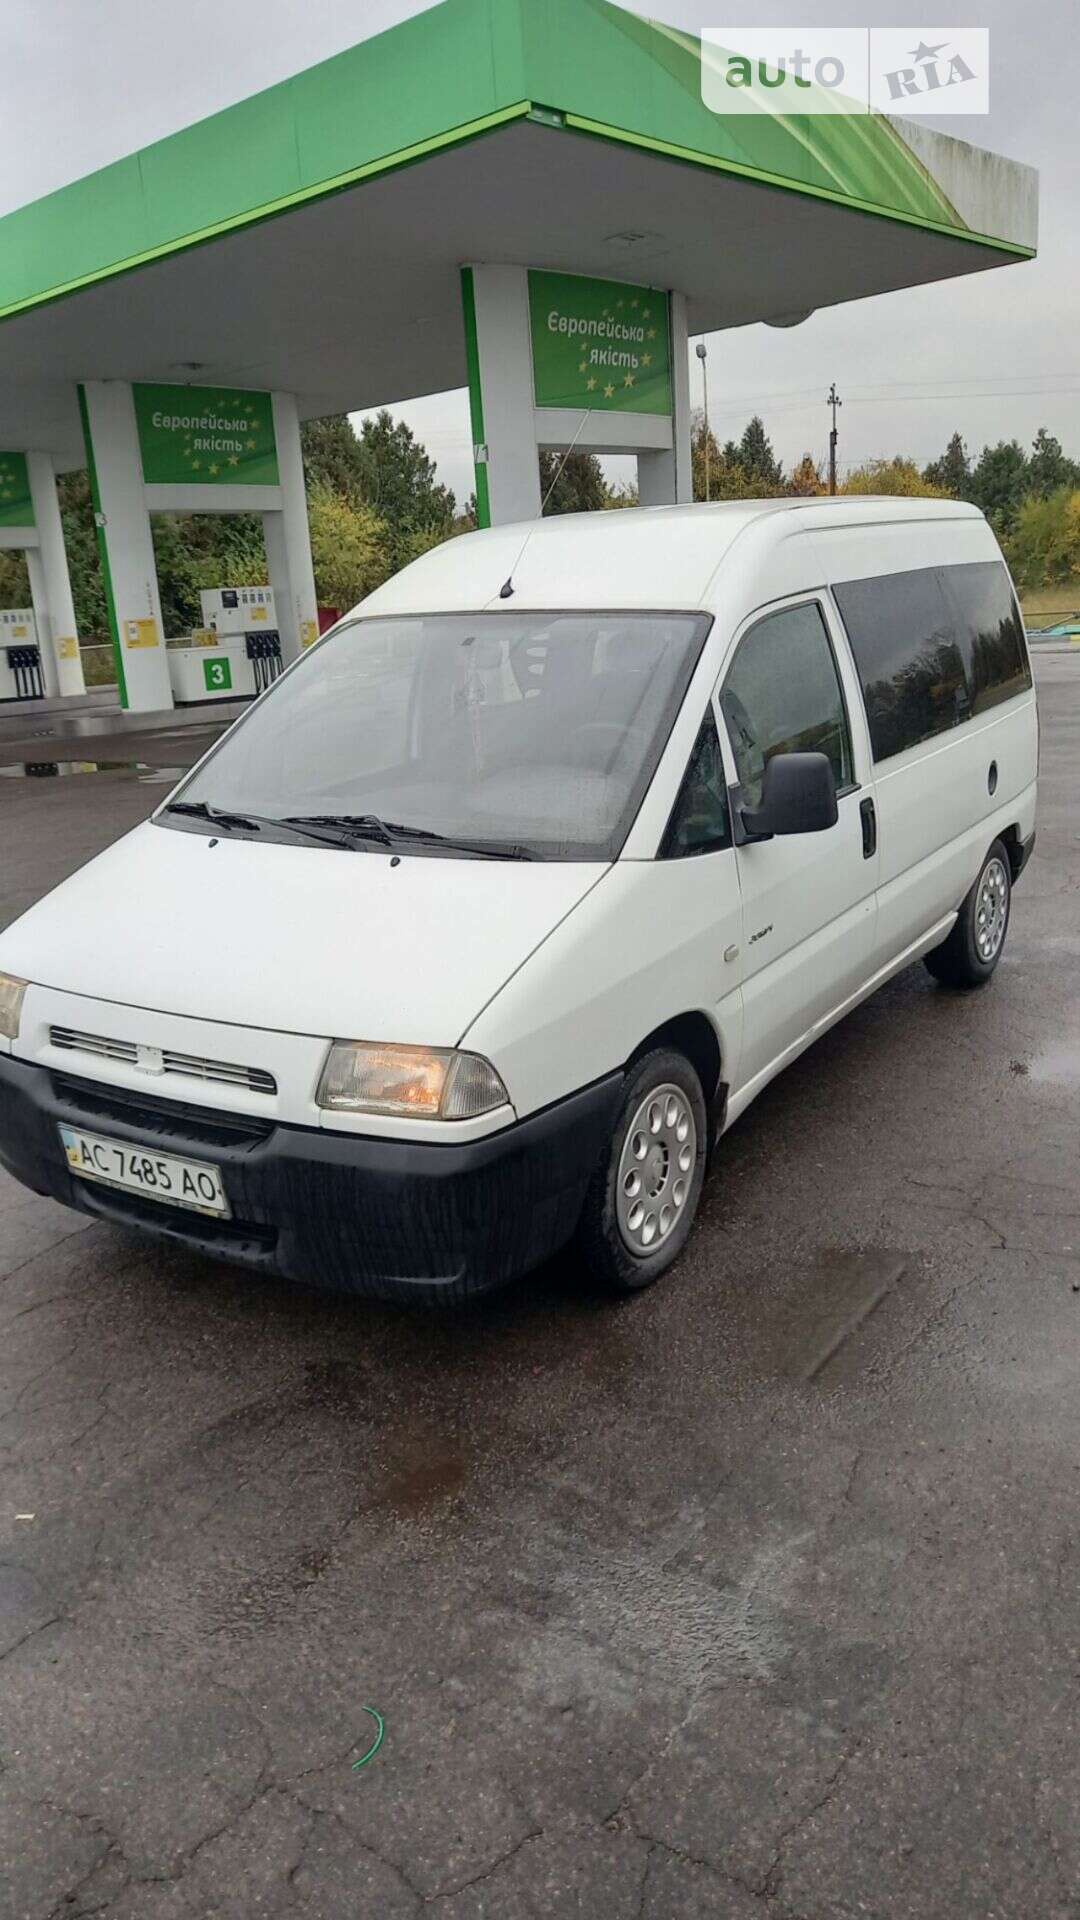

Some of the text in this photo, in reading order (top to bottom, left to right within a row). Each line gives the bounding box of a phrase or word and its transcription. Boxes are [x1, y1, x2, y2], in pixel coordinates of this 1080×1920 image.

[547, 311, 645, 342] Європейська
[590, 345, 639, 368] якість
[152, 412, 248, 431] Європейська
[193, 435, 243, 451] якість
[211, 664, 224, 684] 3
[80, 1139, 110, 1171] AC
[112, 1149, 172, 1190] 7485
[182, 1167, 216, 1201] AO
